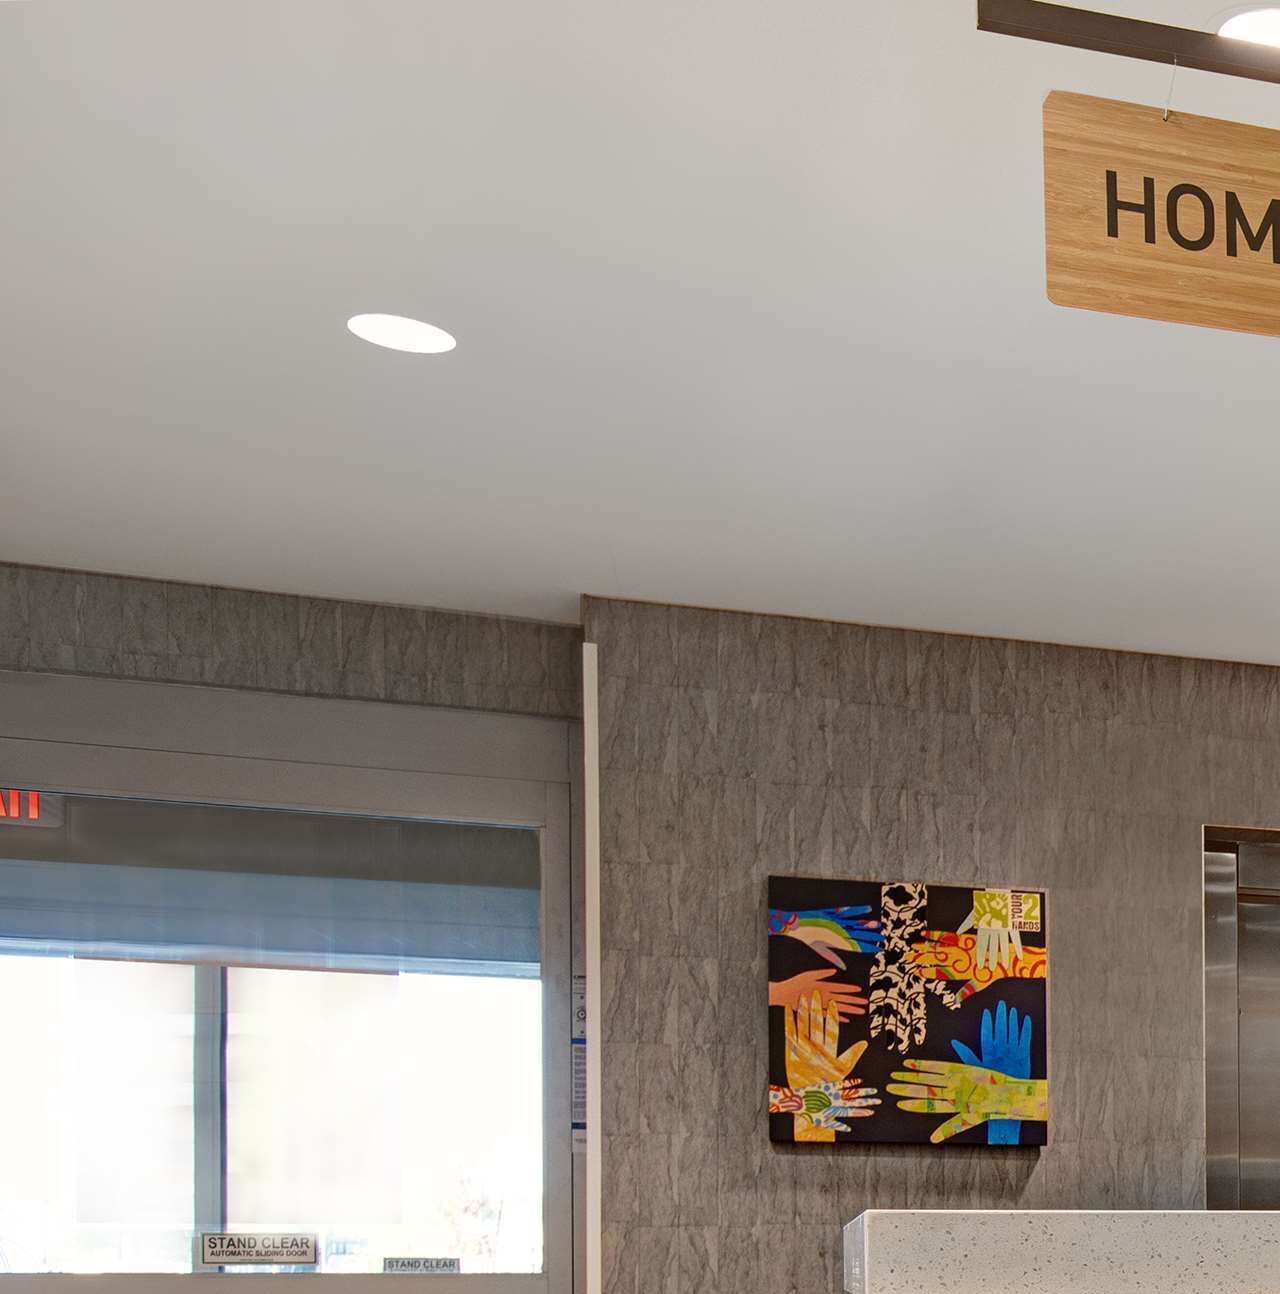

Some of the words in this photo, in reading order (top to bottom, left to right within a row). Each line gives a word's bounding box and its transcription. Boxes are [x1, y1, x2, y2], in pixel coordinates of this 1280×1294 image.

[208, 1236, 257, 1250] STAND
[261, 1236, 311, 1250] CLEAR
[387, 1259, 421, 1270] STAND
[423, 1259, 456, 1270] CLEAR
